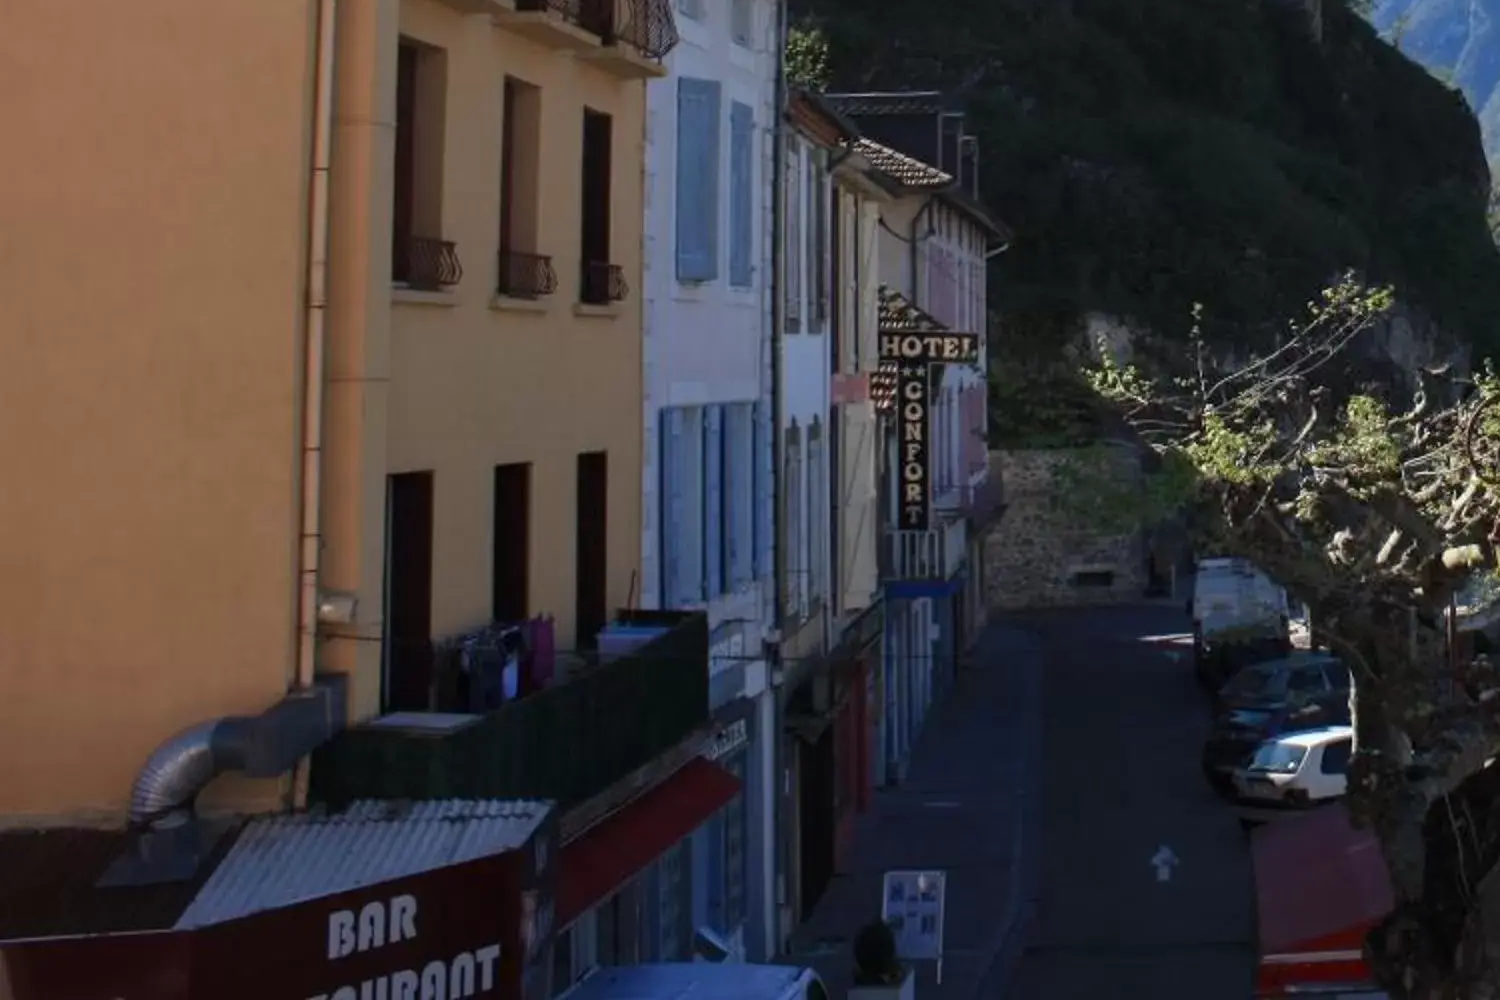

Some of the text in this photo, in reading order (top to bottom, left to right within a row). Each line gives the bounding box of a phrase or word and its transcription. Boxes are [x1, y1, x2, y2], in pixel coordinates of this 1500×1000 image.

[881, 335, 977, 359] HOTEL
[904, 381, 924, 525] CONFORT
[328, 894, 418, 960] BAR
[304, 942, 501, 1000] URANT
